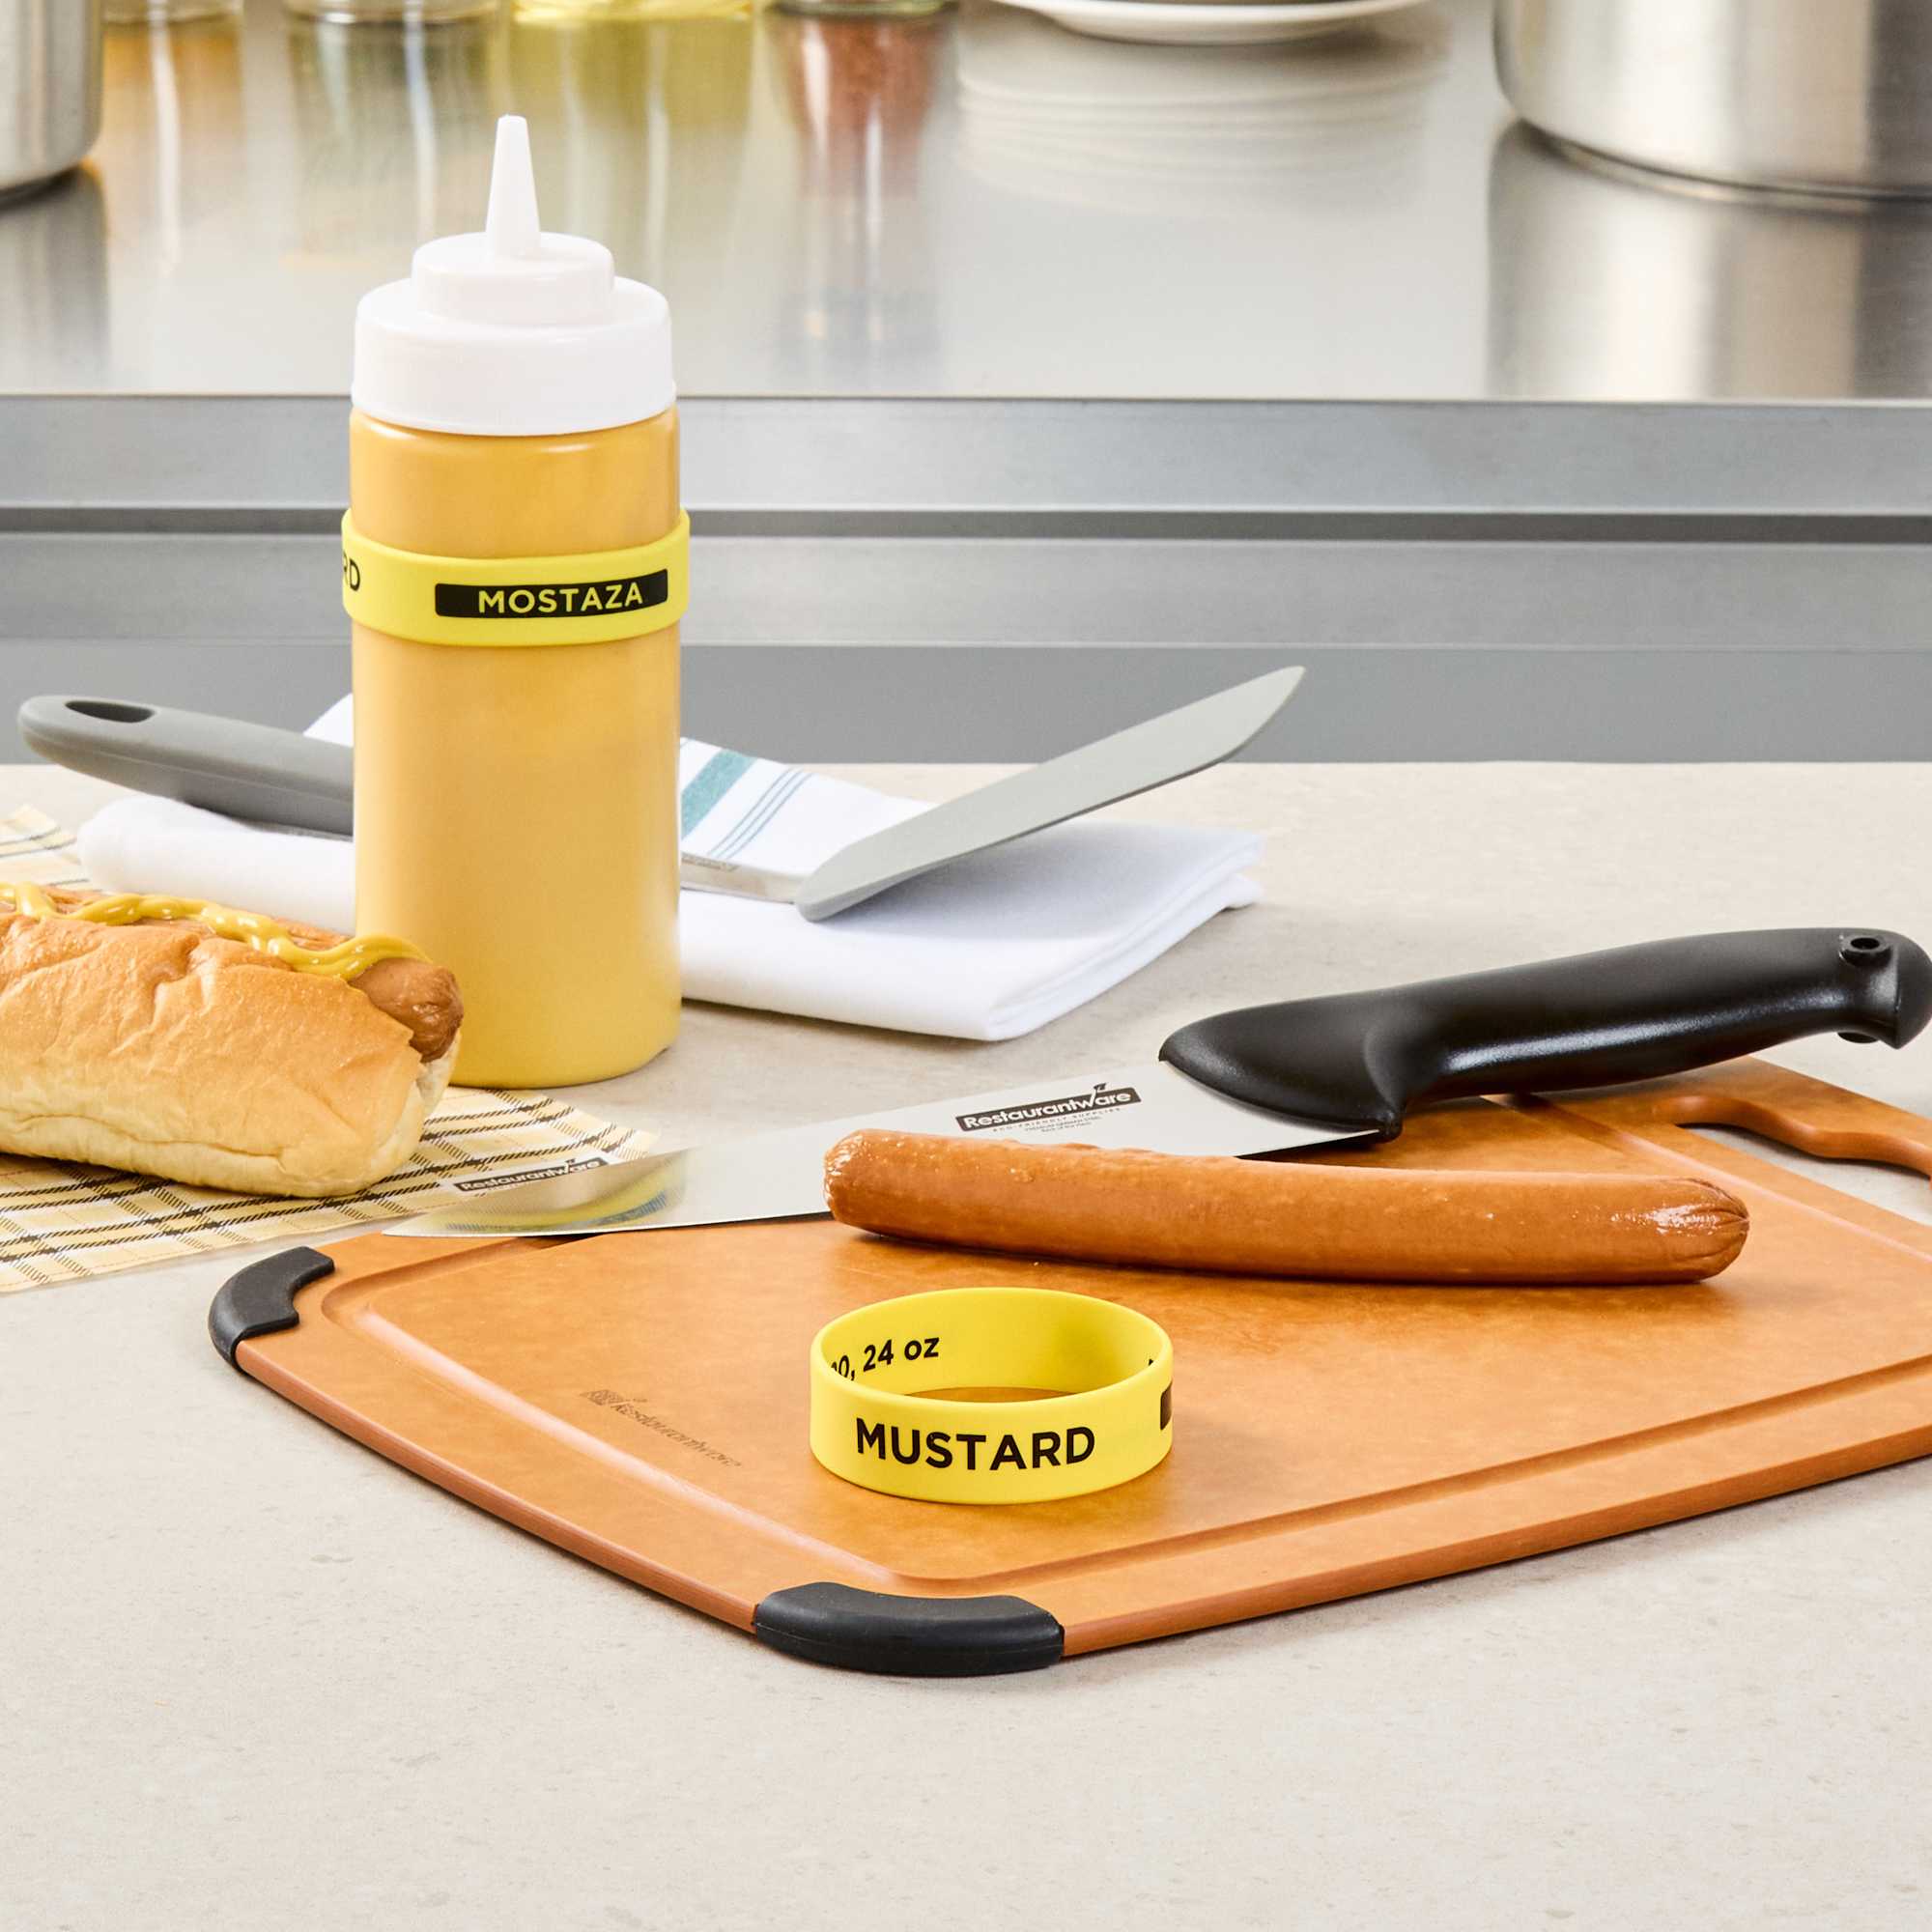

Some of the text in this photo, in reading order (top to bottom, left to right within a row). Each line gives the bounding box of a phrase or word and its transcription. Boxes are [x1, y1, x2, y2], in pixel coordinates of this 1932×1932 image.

[478, 582, 644, 614] MOSTAZA
[963, 1089, 1131, 1129] Restaurantware
[460, 1159, 601, 1192] Restaurantware
[863, 1339, 895, 1373] 24
[904, 1337, 940, 1361] oz
[856, 1417, 1095, 1471] MUSTARD
